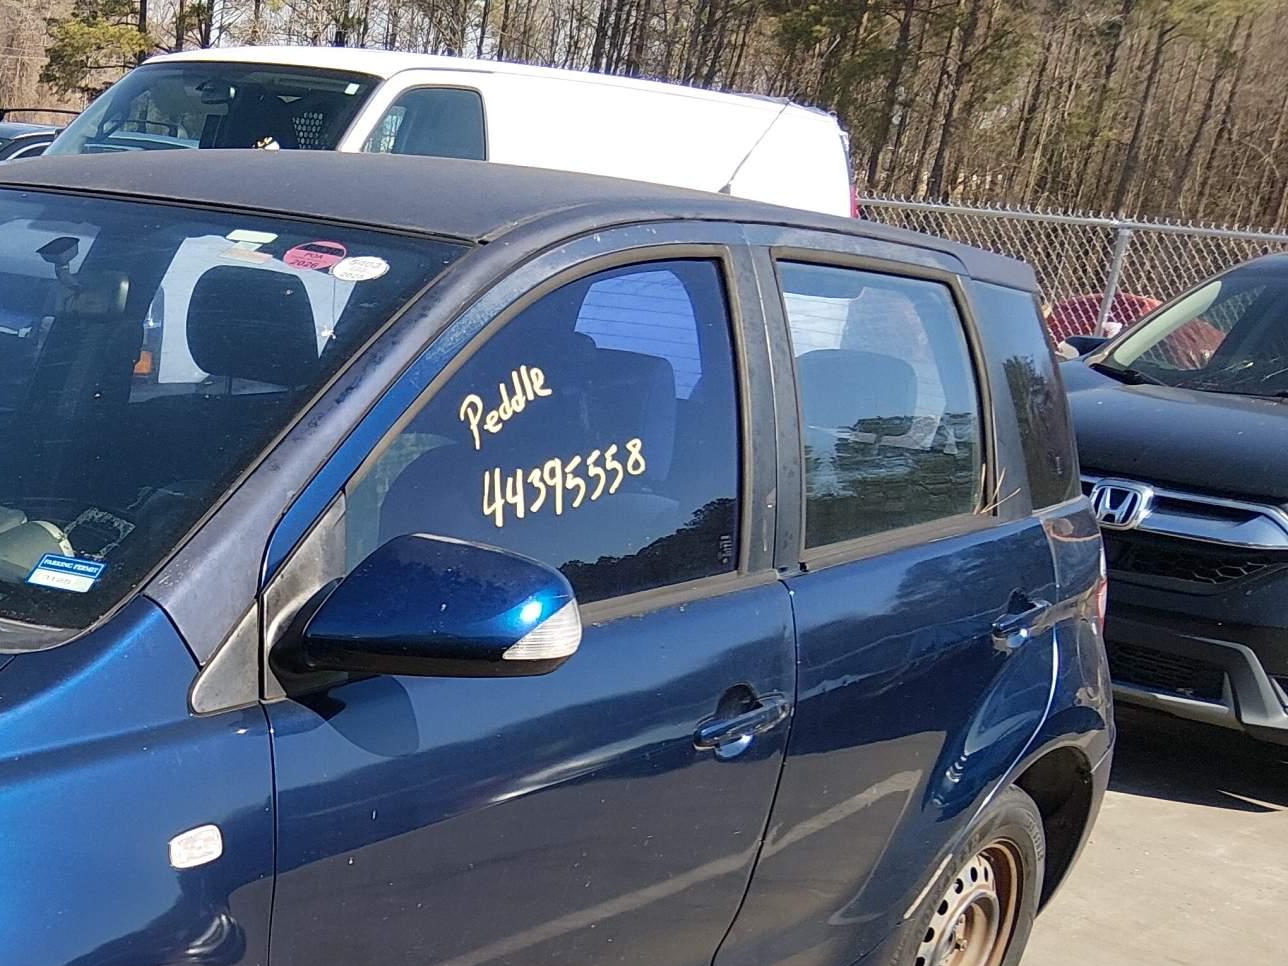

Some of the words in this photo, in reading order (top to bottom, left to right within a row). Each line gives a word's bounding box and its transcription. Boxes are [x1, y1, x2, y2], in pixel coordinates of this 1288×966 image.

[288, 259, 319, 269] 2026
[459, 364, 553, 450] Peddle
[482, 437, 647, 528] 44395558
